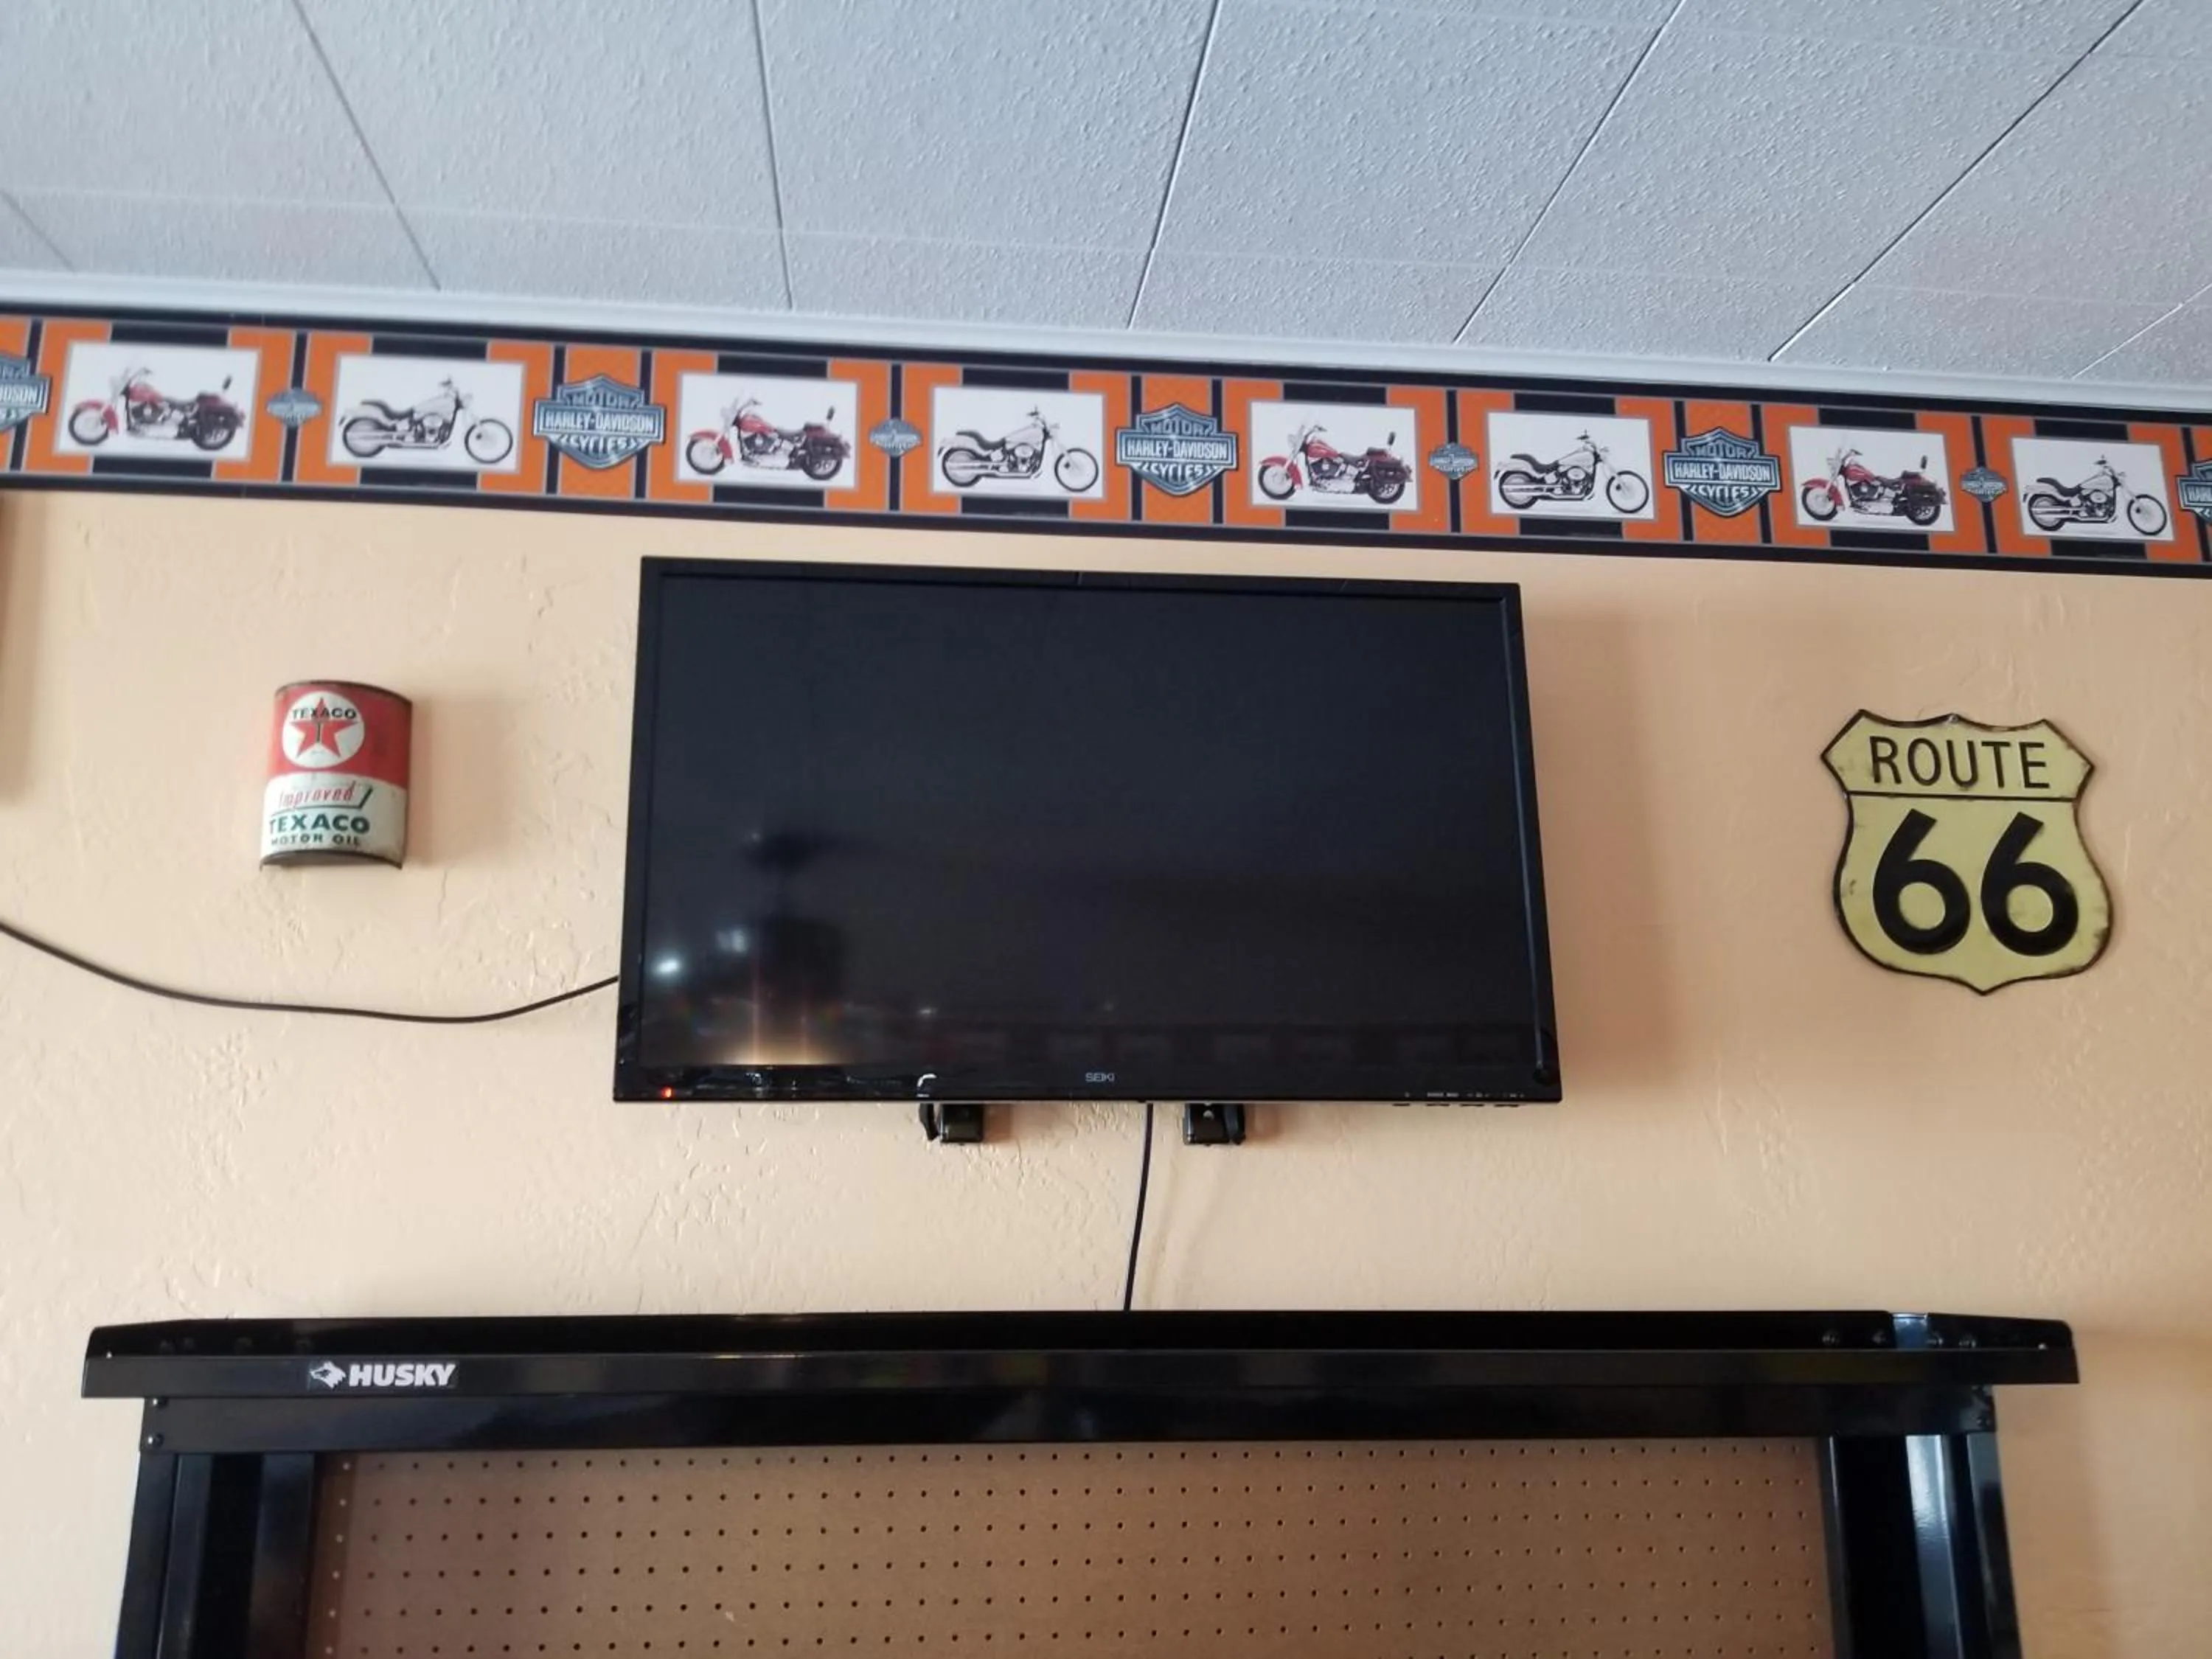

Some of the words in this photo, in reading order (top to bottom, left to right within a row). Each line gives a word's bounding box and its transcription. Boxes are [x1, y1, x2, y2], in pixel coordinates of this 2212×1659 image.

[545, 411, 654, 432] HARLEY-DAVIDSON
[1127, 439, 1228, 459] HARLEY-DAVIDSON
[1674, 462, 1770, 481] HARLEY-DAVIDSON
[293, 707, 357, 720] TEXACO
[1870, 736, 2051, 790] ROUTE
[269, 813, 370, 834] TEXACO
[271, 833, 323, 846] MOTOR
[333, 834, 361, 846] OIL
[1873, 808, 2079, 956] 66
[349, 1364, 456, 1387] HUSKY
